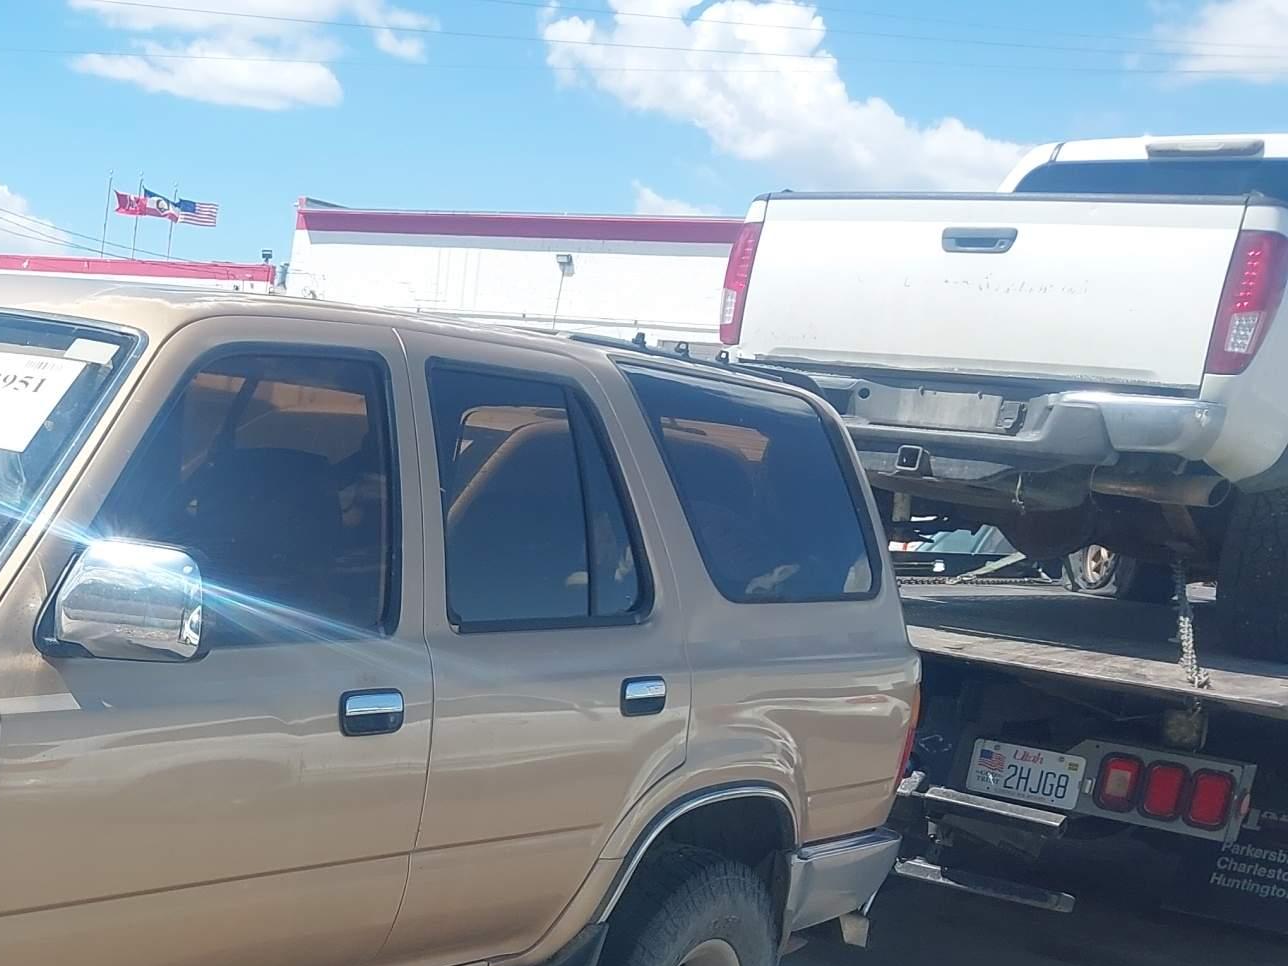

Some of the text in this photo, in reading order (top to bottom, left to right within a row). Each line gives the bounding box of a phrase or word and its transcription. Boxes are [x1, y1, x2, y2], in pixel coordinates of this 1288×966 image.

[1013, 749, 1044, 765] Utah
[1003, 765, 1069, 799] 2HJG8
[1221, 840, 1288, 865] Parkersb
[1209, 872, 1288, 898] Huntingto
